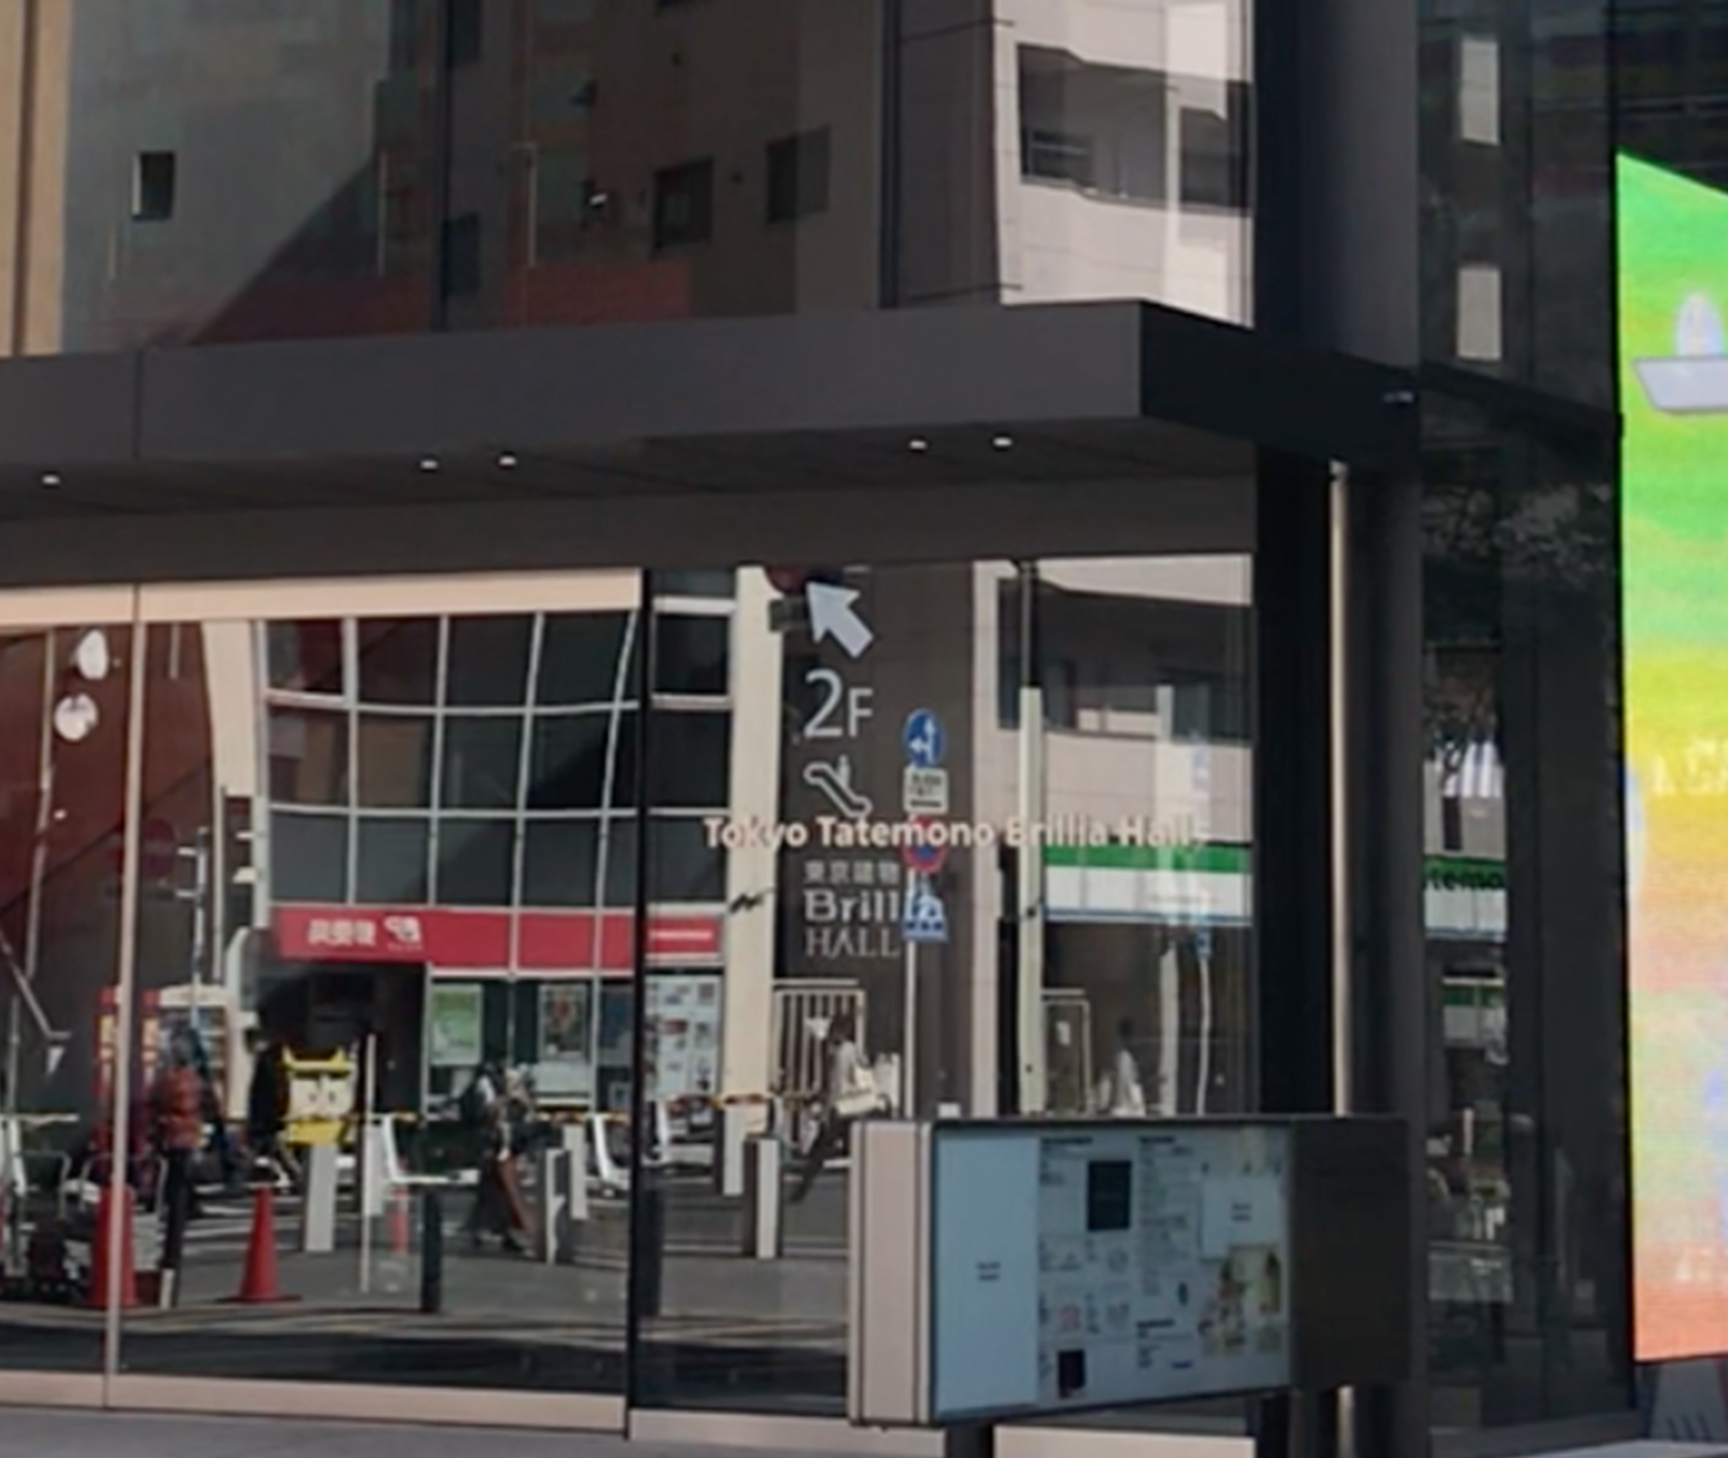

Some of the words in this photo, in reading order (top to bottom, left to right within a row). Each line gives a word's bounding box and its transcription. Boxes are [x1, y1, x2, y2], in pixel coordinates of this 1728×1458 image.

[804, 668, 874, 739] 2F
[704, 816, 808, 847] Tokyo
[816, 815, 995, 847] Tatemono
[1005, 816, 1109, 847] Brillia
[1118, 814, 1190, 847] Hall
[805, 926, 901, 960] HALL
